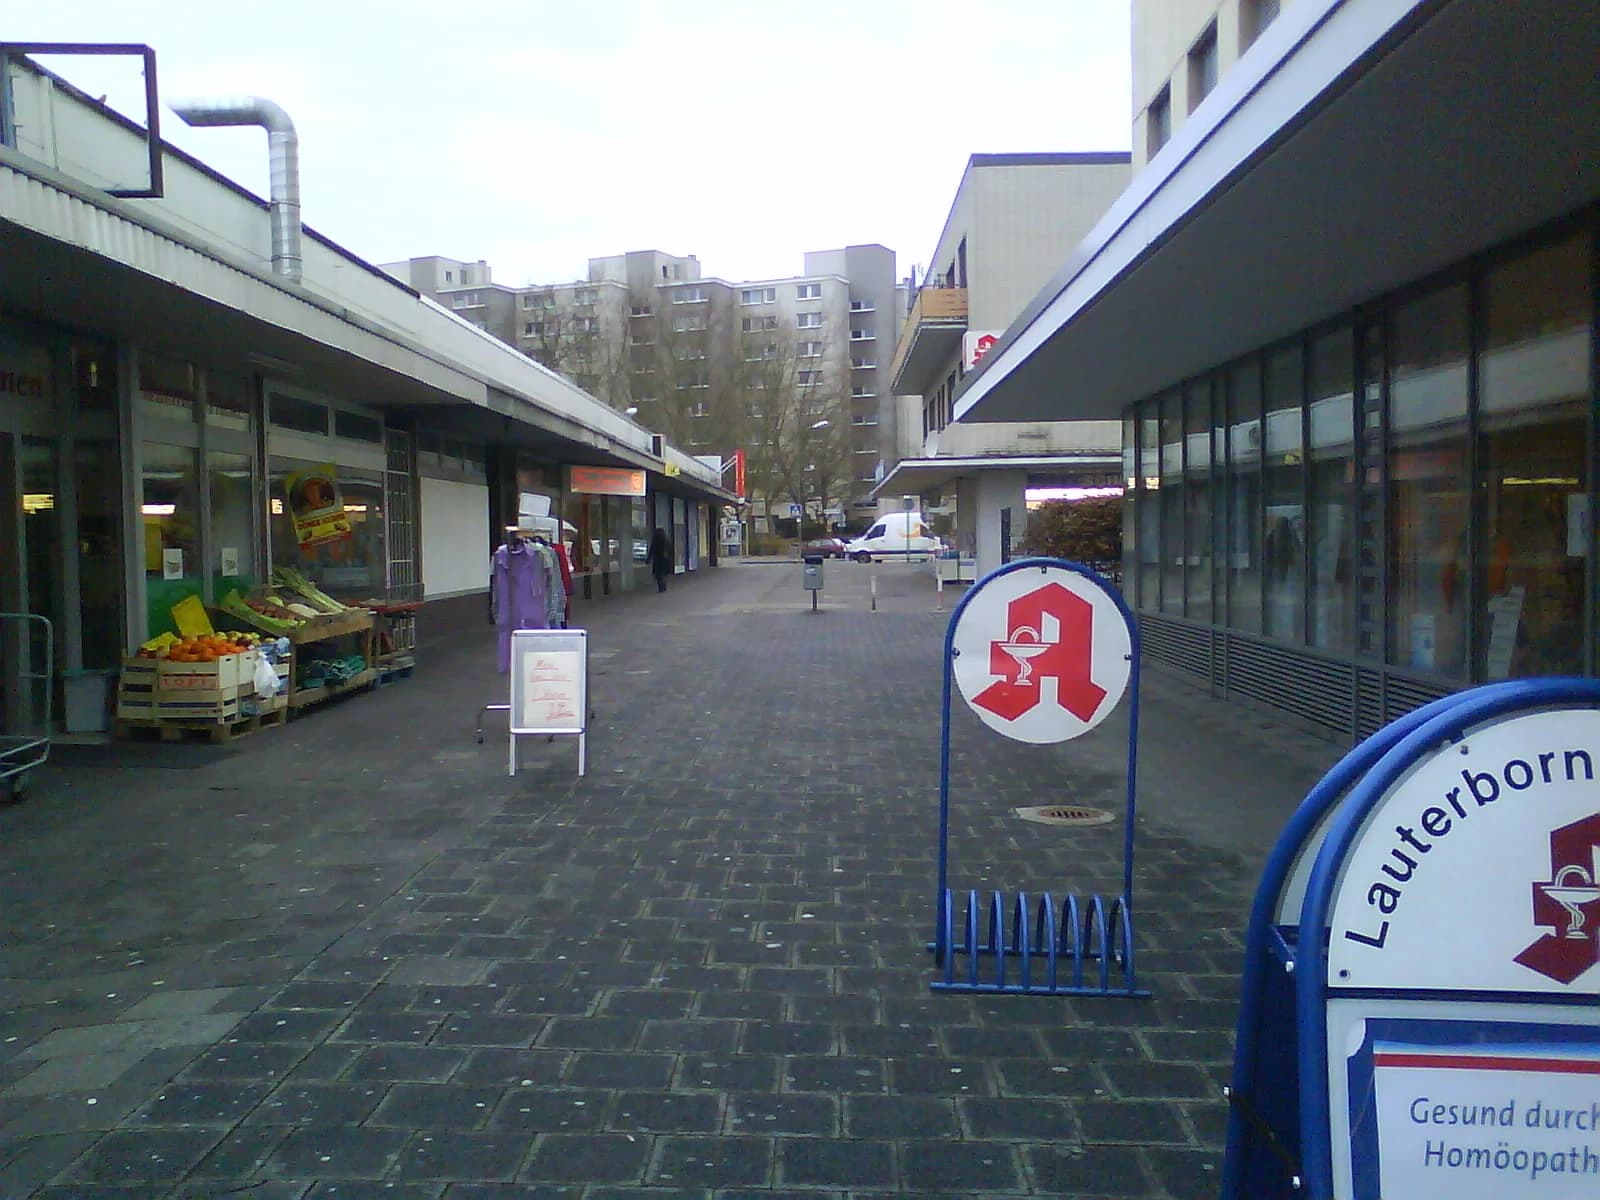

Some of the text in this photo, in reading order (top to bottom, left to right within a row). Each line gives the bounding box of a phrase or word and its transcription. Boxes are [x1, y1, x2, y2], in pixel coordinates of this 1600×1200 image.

[1345, 749, 1594, 949] Lauterborn
[1410, 1097, 1515, 1127] Gesund
[1424, 1139, 1600, 1180] Homöopath
